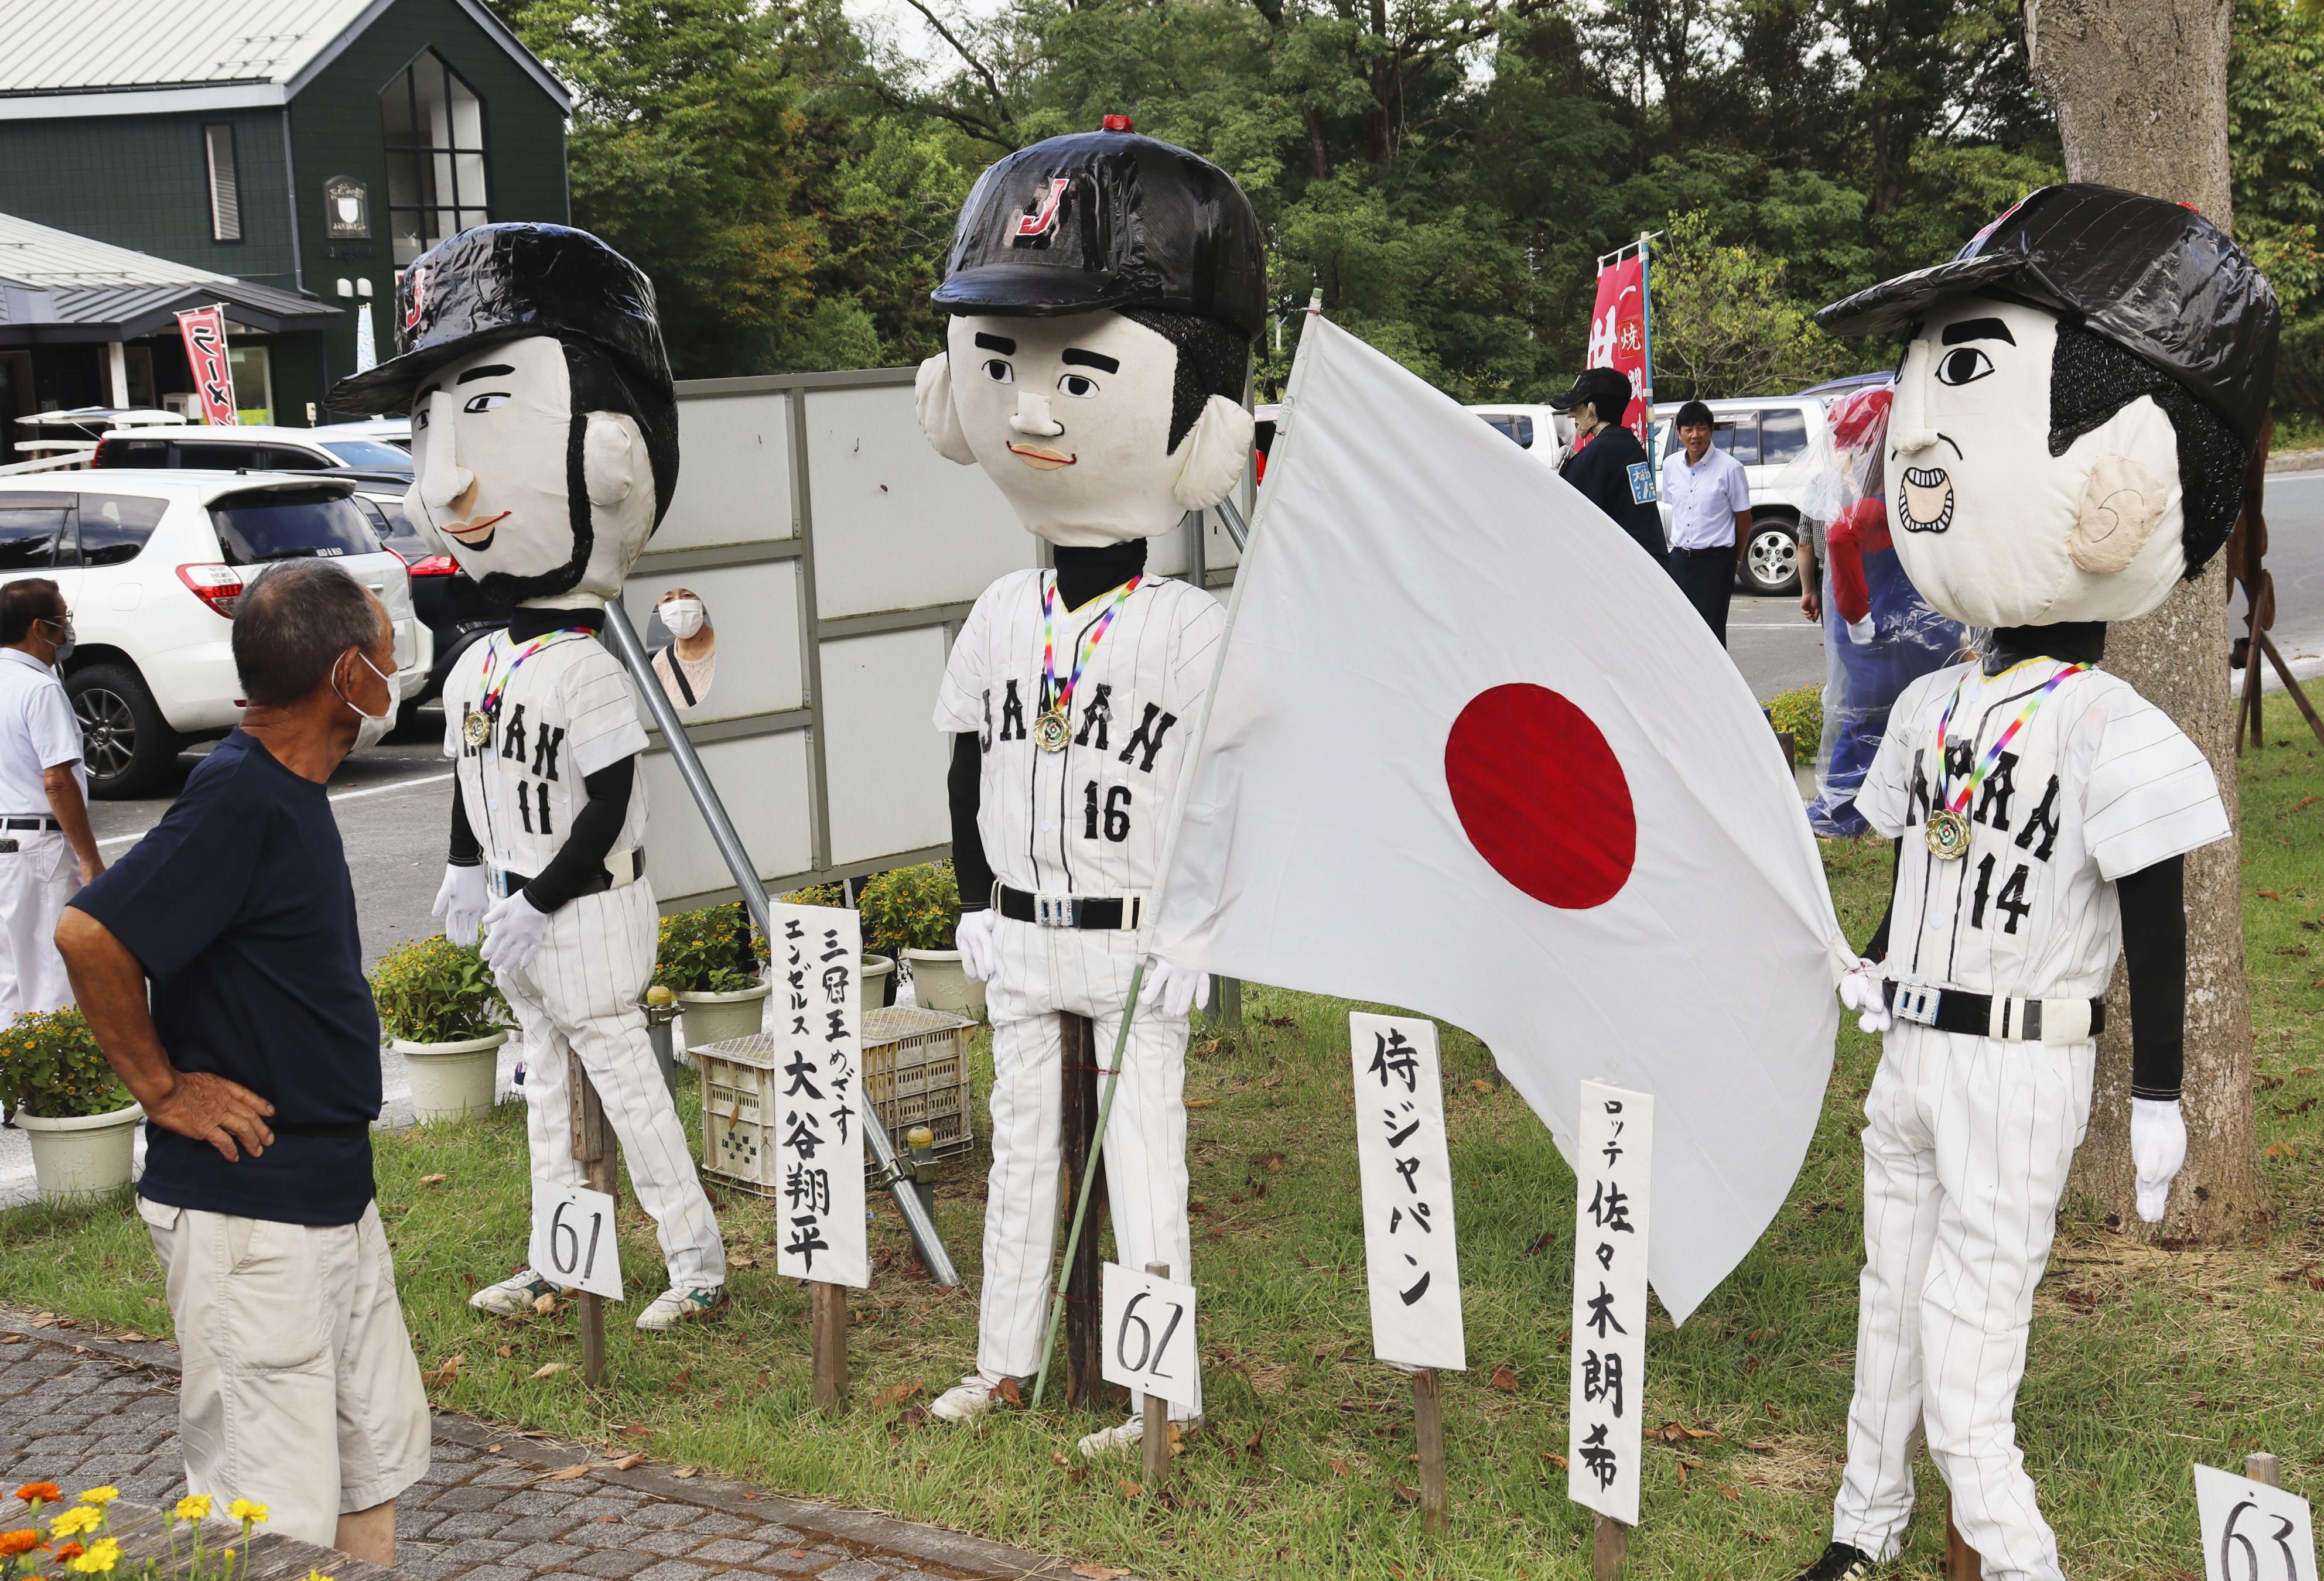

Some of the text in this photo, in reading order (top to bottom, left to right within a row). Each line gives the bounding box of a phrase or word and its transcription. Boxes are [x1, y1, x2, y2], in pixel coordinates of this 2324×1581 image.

[1016, 179, 1070, 235] J
[517, 779, 553, 835] 11
[1084, 780, 1132, 843] 16
[1971, 852, 2032, 935] 14
[819, 929, 856, 1146] 三冠王めざす
[782, 919, 830, 1275] エンゼルス 大谷翔平
[1366, 1027, 1431, 1306] 侍ジャパン
[550, 1201, 601, 1279] 61
[1117, 1292, 1184, 1379] 62
[1578, 1100, 1635, 1494] ロッテ 佐々木朗希
[2220, 1501, 2298, 1581] 63
